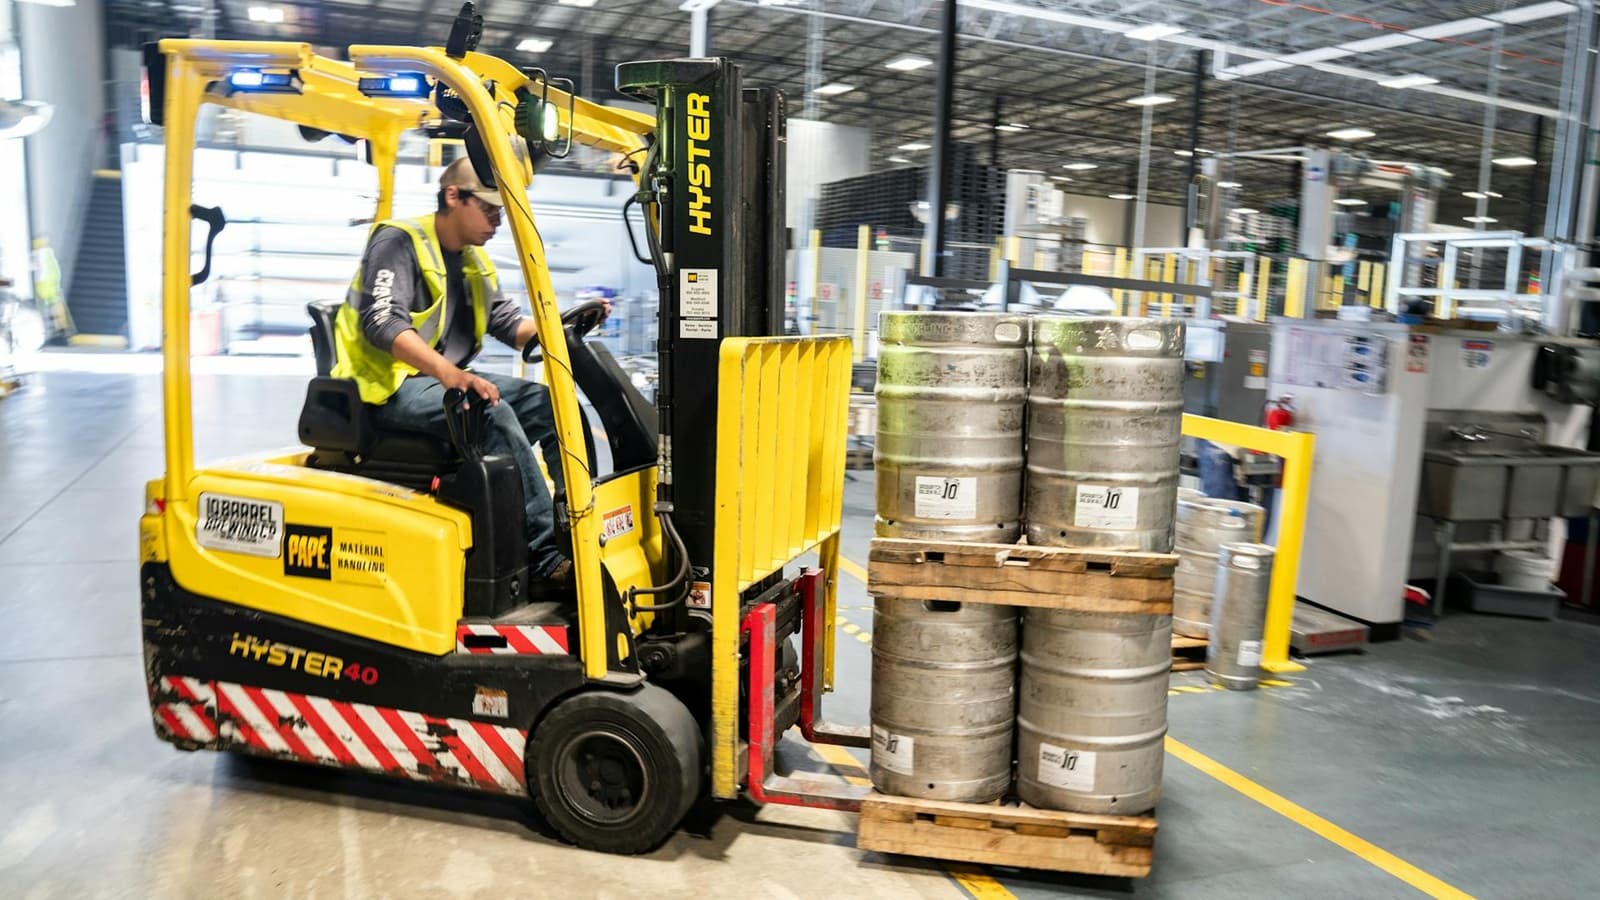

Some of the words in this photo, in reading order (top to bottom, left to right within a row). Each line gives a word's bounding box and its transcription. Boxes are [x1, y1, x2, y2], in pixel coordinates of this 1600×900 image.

[687, 92, 712, 235] HYSTER
[941, 482, 958, 500] 10
[1103, 491, 1120, 509] 10
[221, 499, 275, 523] BARREL
[339, 542, 384, 558] MATERIAL
[338, 558, 385, 573] HANDLING
[229, 632, 344, 681] HYSTER
[344, 661, 379, 686] 40
